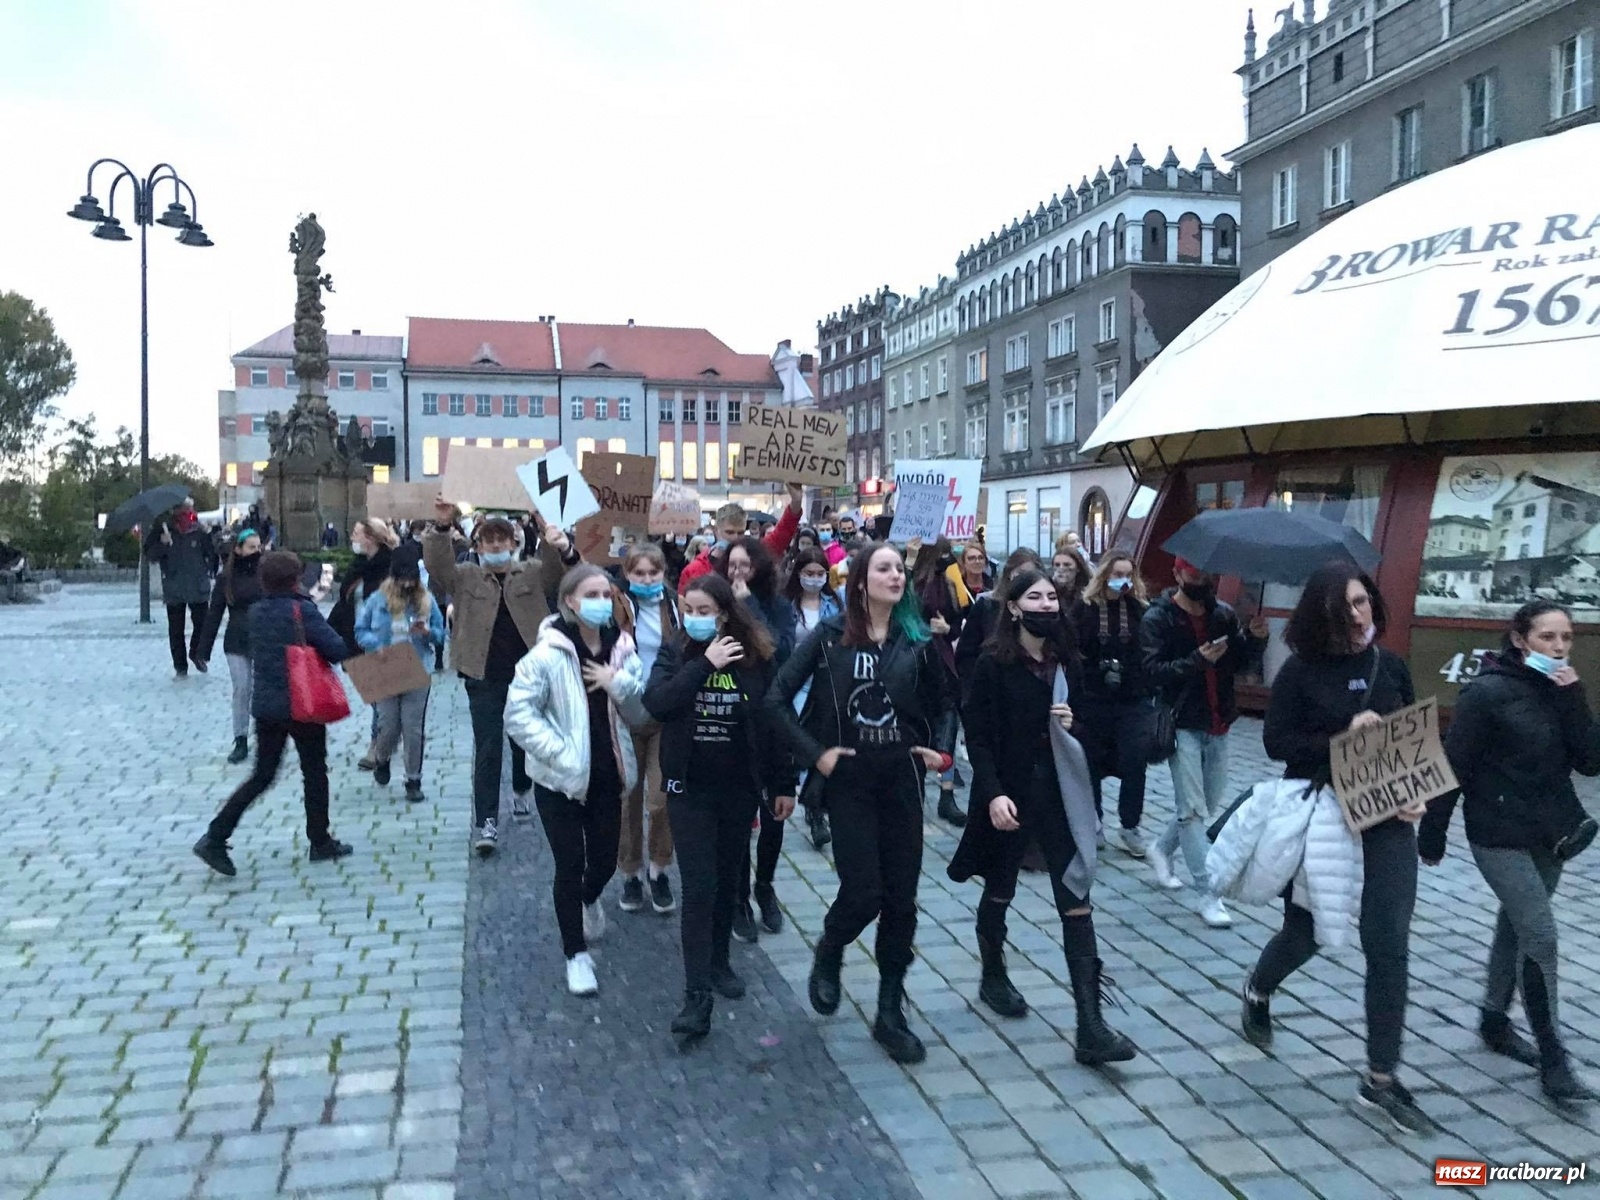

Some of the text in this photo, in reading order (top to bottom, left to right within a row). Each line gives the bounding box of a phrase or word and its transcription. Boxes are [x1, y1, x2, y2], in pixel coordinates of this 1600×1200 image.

[1293, 221, 1521, 295] BROWAR
[1491, 254, 1549, 273] Rok
[748, 405, 839, 438] REAL MEN
[765, 431, 815, 454] ARE
[743, 445, 846, 477] FEMINISTS
[1338, 703, 1433, 763] TO JEST
[1339, 736, 1428, 793] WOJNA Z
[1345, 760, 1446, 825] KOBIETAMI
